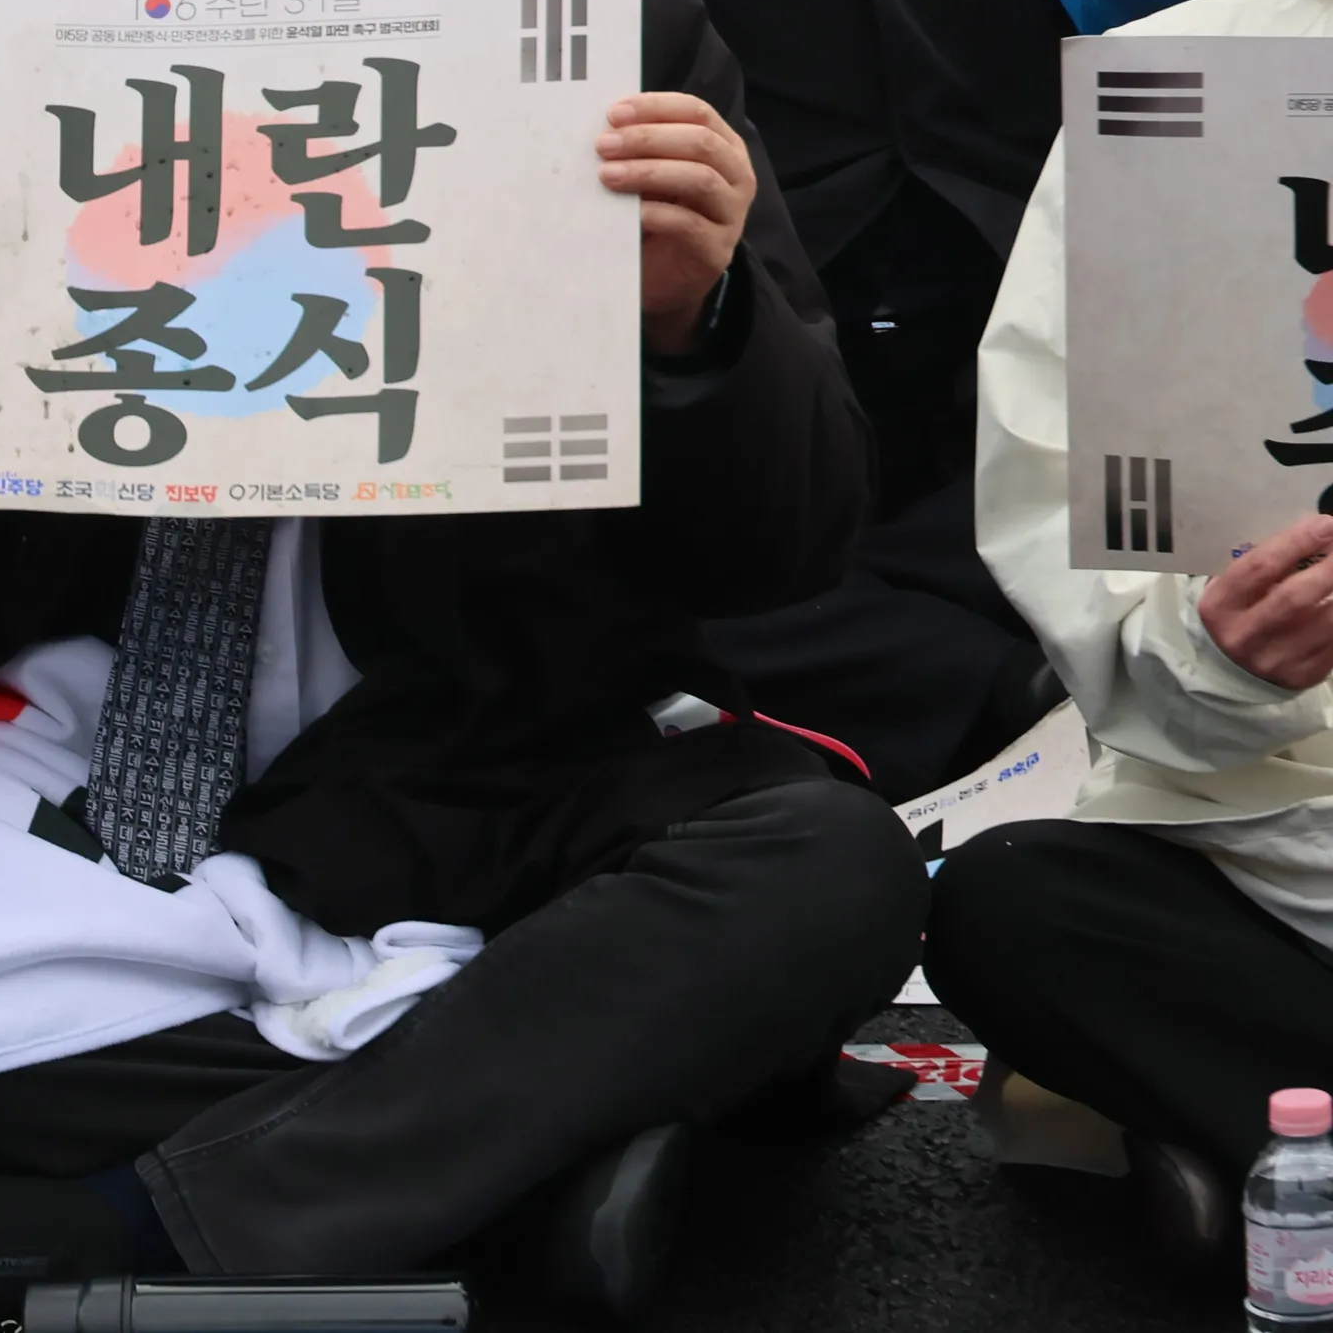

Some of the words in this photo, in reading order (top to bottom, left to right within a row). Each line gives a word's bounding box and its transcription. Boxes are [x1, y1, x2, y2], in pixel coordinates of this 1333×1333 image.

[45, 56, 458, 257] 내란
[23, 267, 424, 467] 종식
[166, 484, 217, 502] 진보당
